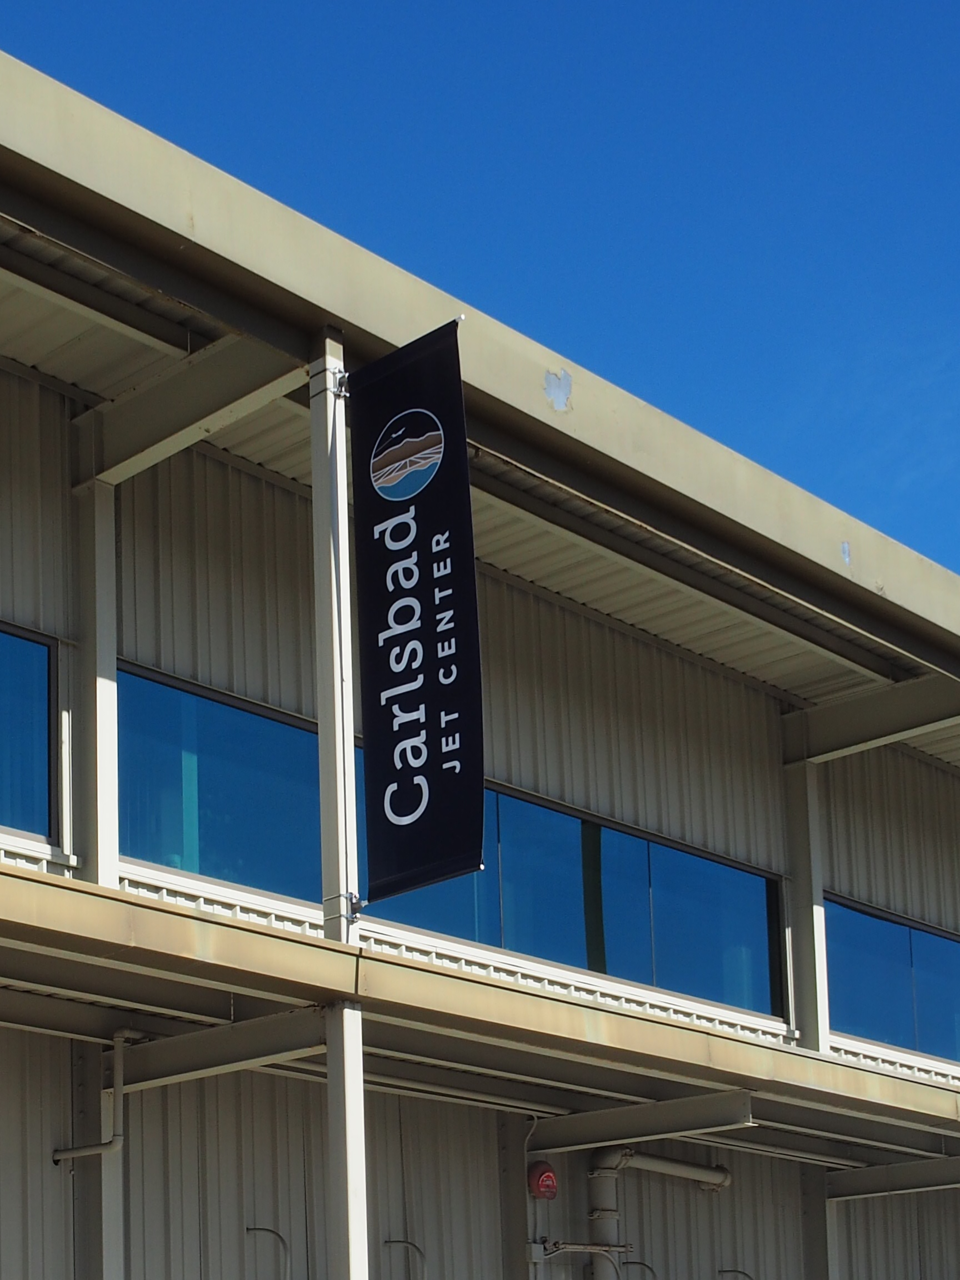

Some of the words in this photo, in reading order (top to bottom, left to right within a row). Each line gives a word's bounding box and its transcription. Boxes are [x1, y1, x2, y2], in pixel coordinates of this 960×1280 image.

[373, 505, 429, 826] Carlsbad
[431, 530, 458, 685] CENTER
[441, 710, 461, 774] JET
